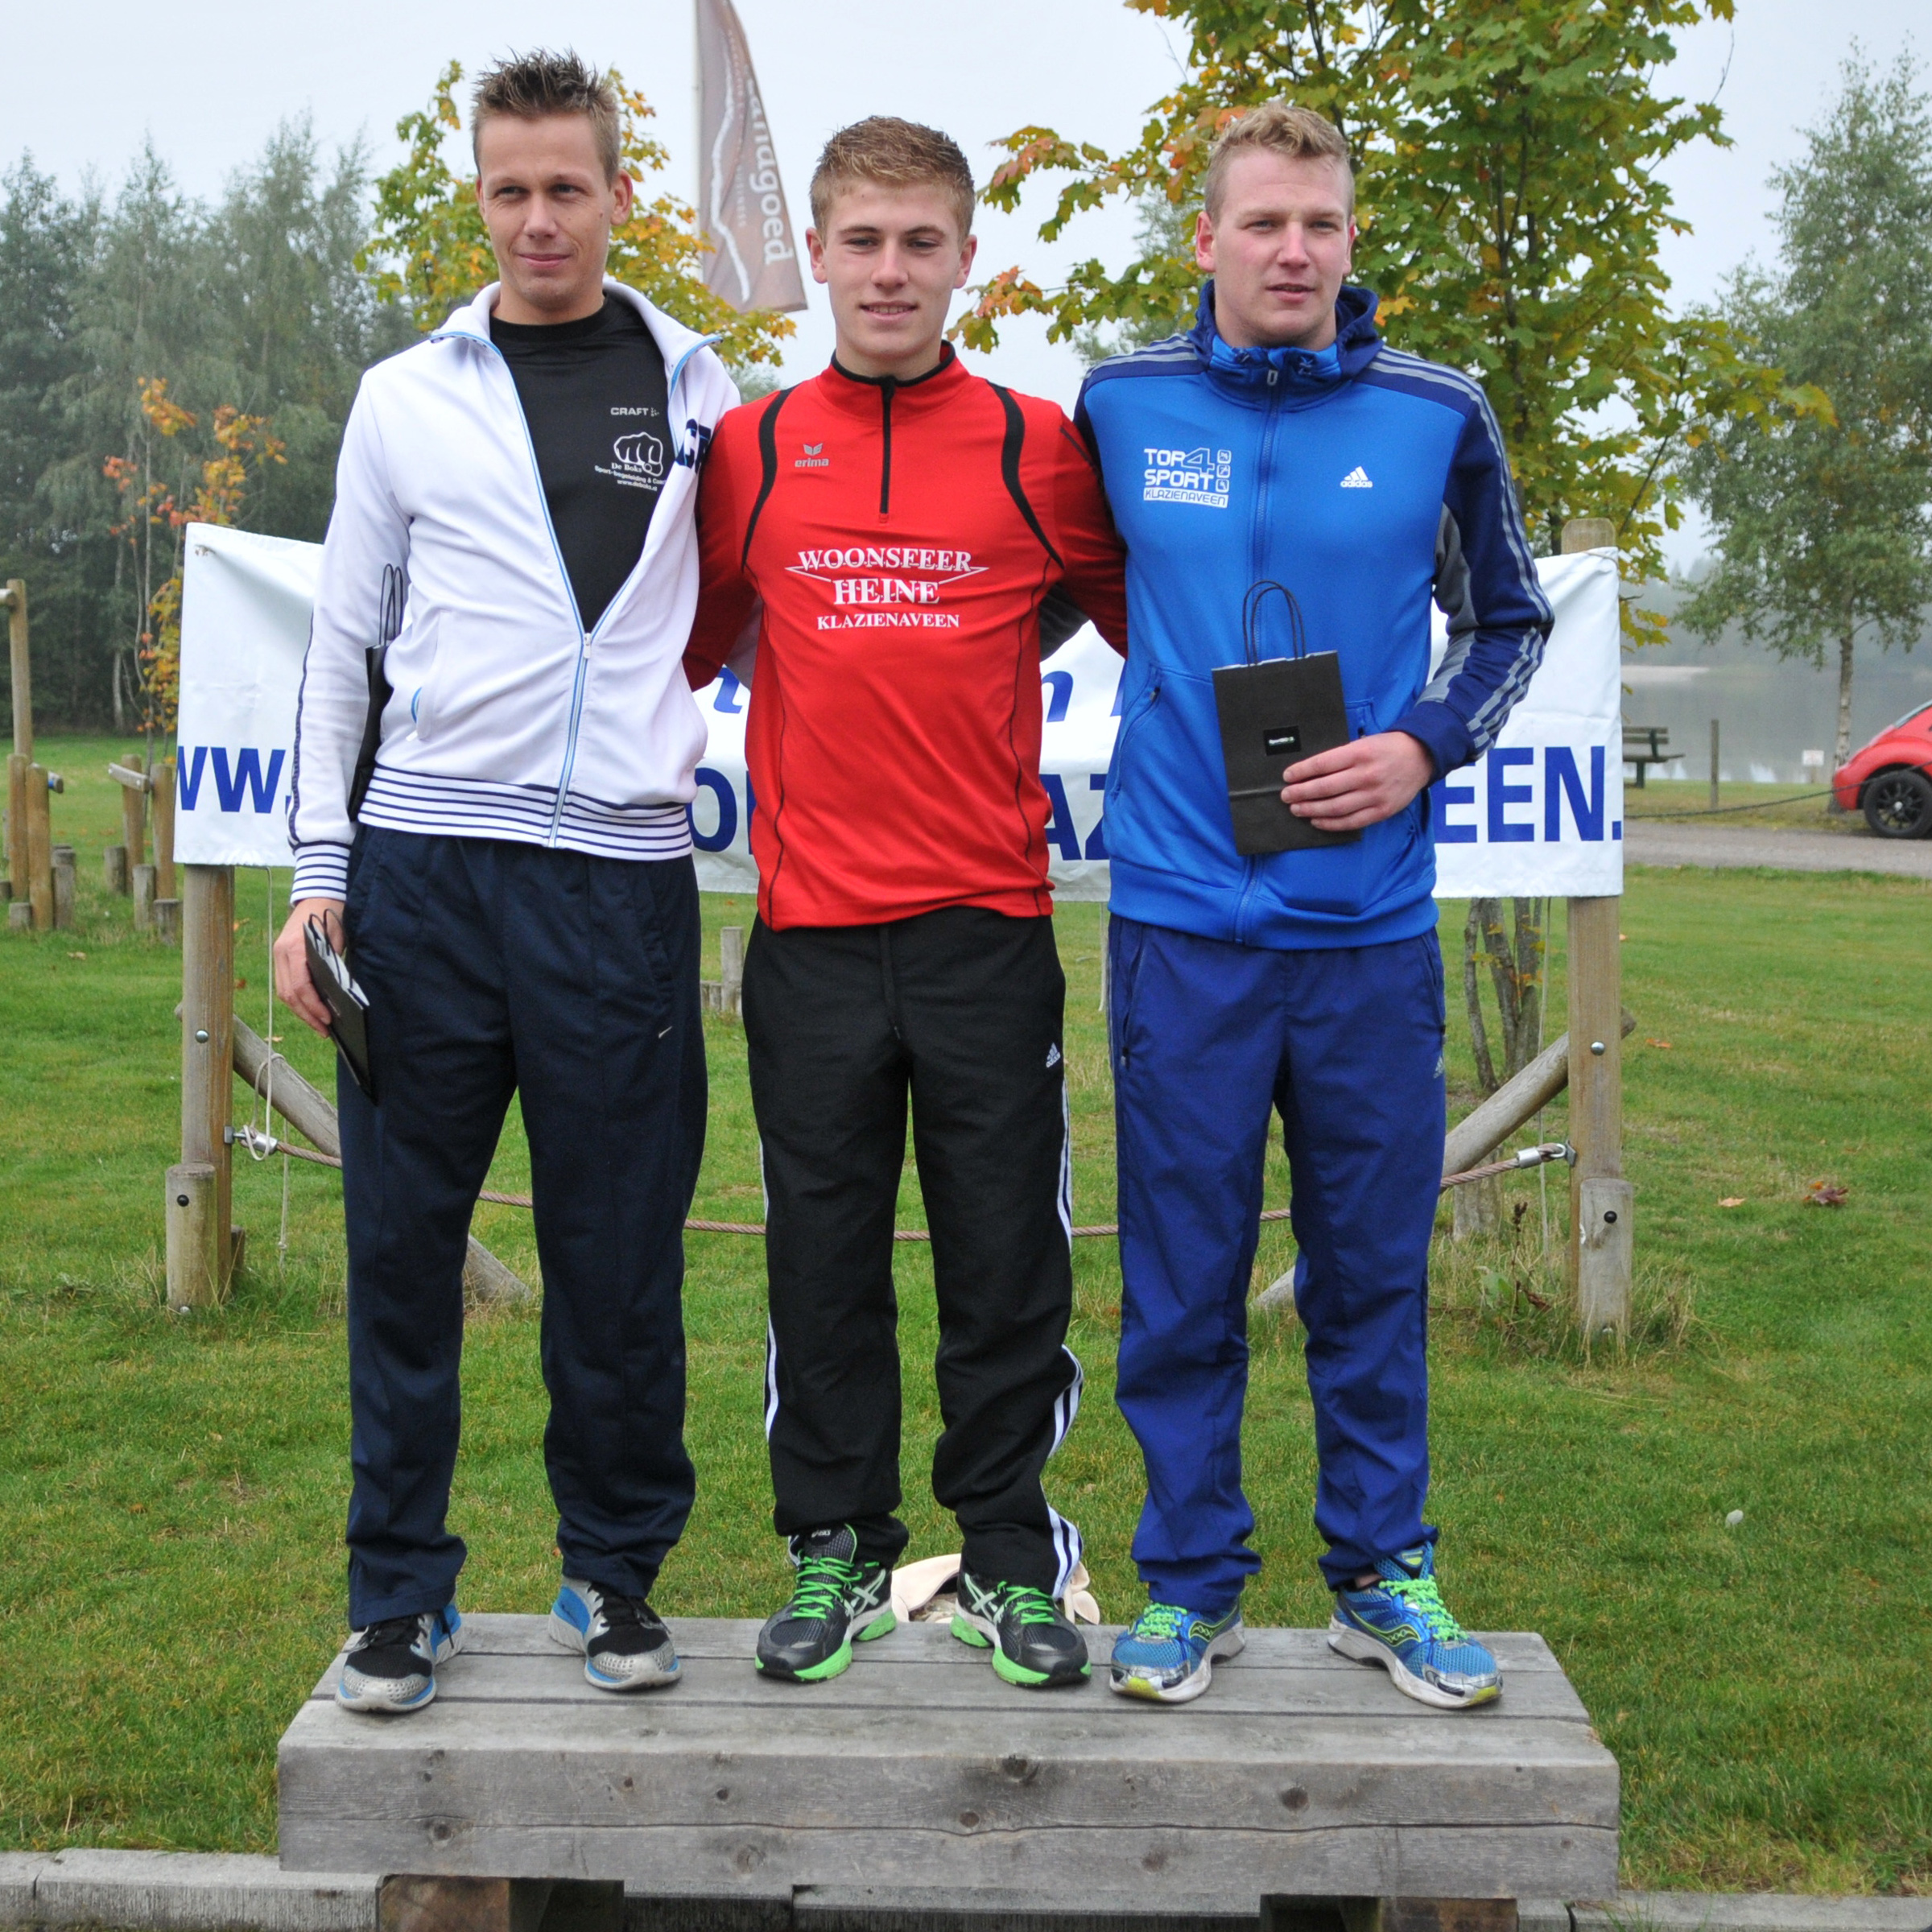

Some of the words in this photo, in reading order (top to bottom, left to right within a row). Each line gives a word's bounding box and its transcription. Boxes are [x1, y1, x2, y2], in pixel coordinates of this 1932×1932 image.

[747, 79, 794, 266] andgoed
[610, 407, 649, 416] CRAFT
[624, 464, 642, 473] Boks
[795, 457, 829, 467] erima
[1144, 469, 1214, 490] SPORT
[1146, 489, 1225, 506] KLAZIENAVEEN
[798, 547, 972, 572] WOONSFEER
[832, 577, 940, 605] HEINE
[817, 612, 960, 630] KLAZIENAVEEN
